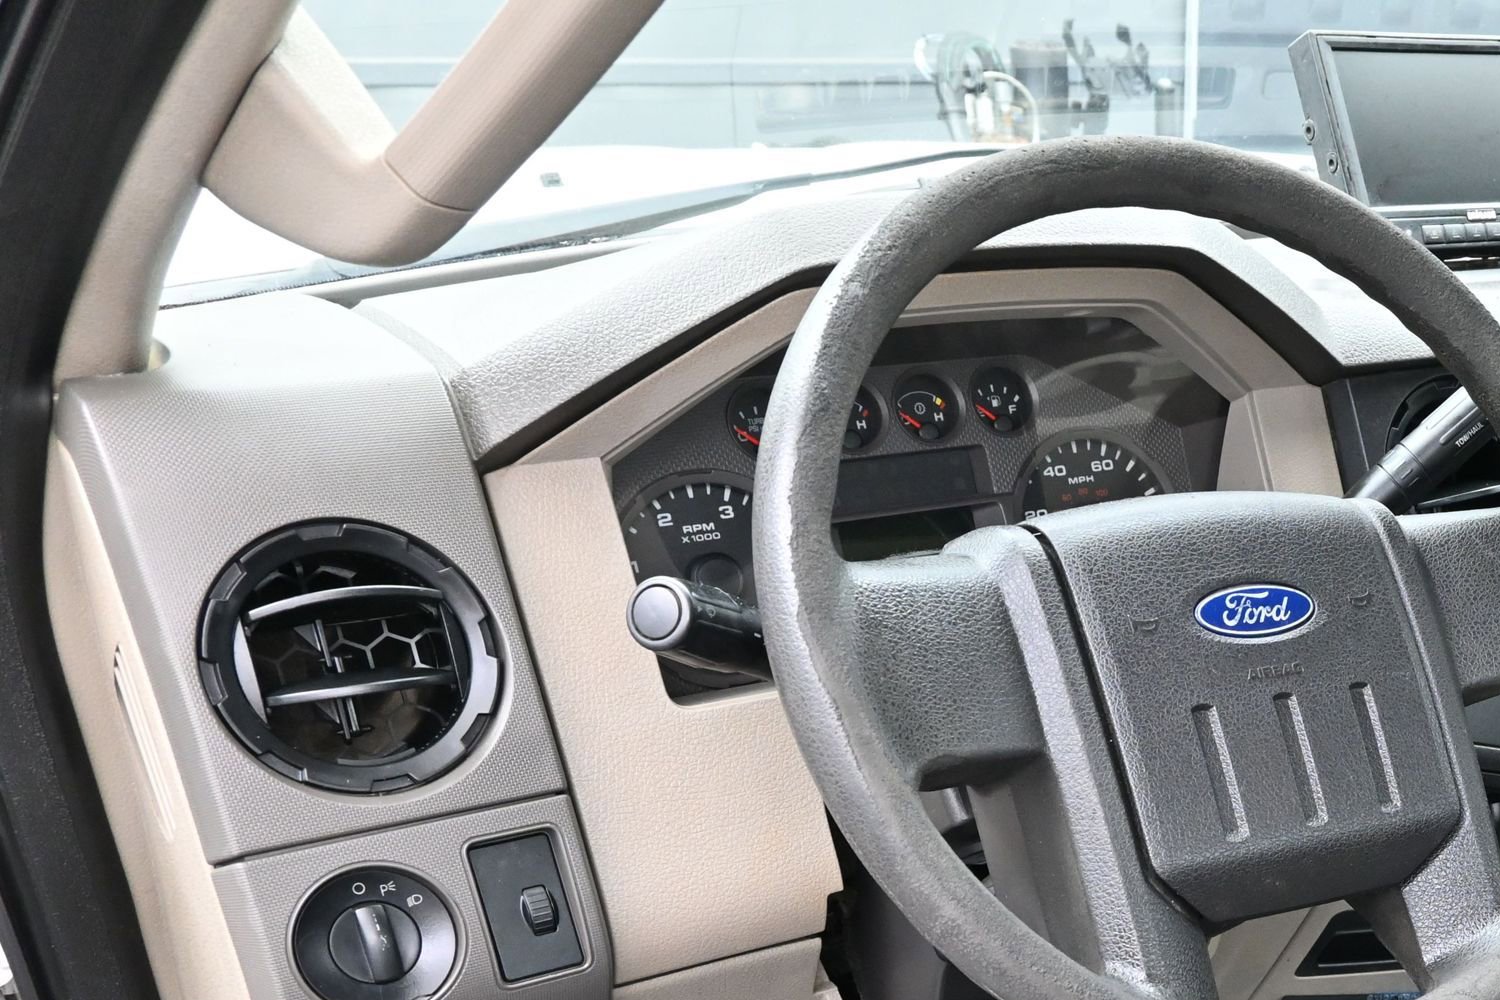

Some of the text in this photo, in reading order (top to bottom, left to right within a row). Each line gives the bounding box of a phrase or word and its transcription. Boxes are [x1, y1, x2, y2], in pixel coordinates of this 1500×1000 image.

[1008, 404, 1017, 415] F
[933, 412, 944, 422] H
[856, 419, 867, 431] H
[1455, 422, 1485, 448] TOW/HAUL
[1043, 465, 1067, 477] 40
[1090, 459, 1114, 472] 60
[1067, 475, 1095, 485] MPH
[656, 505, 735, 527] 2 3
[681, 522, 715, 534] RPM
[1222, 591, 1291, 627] Ford
